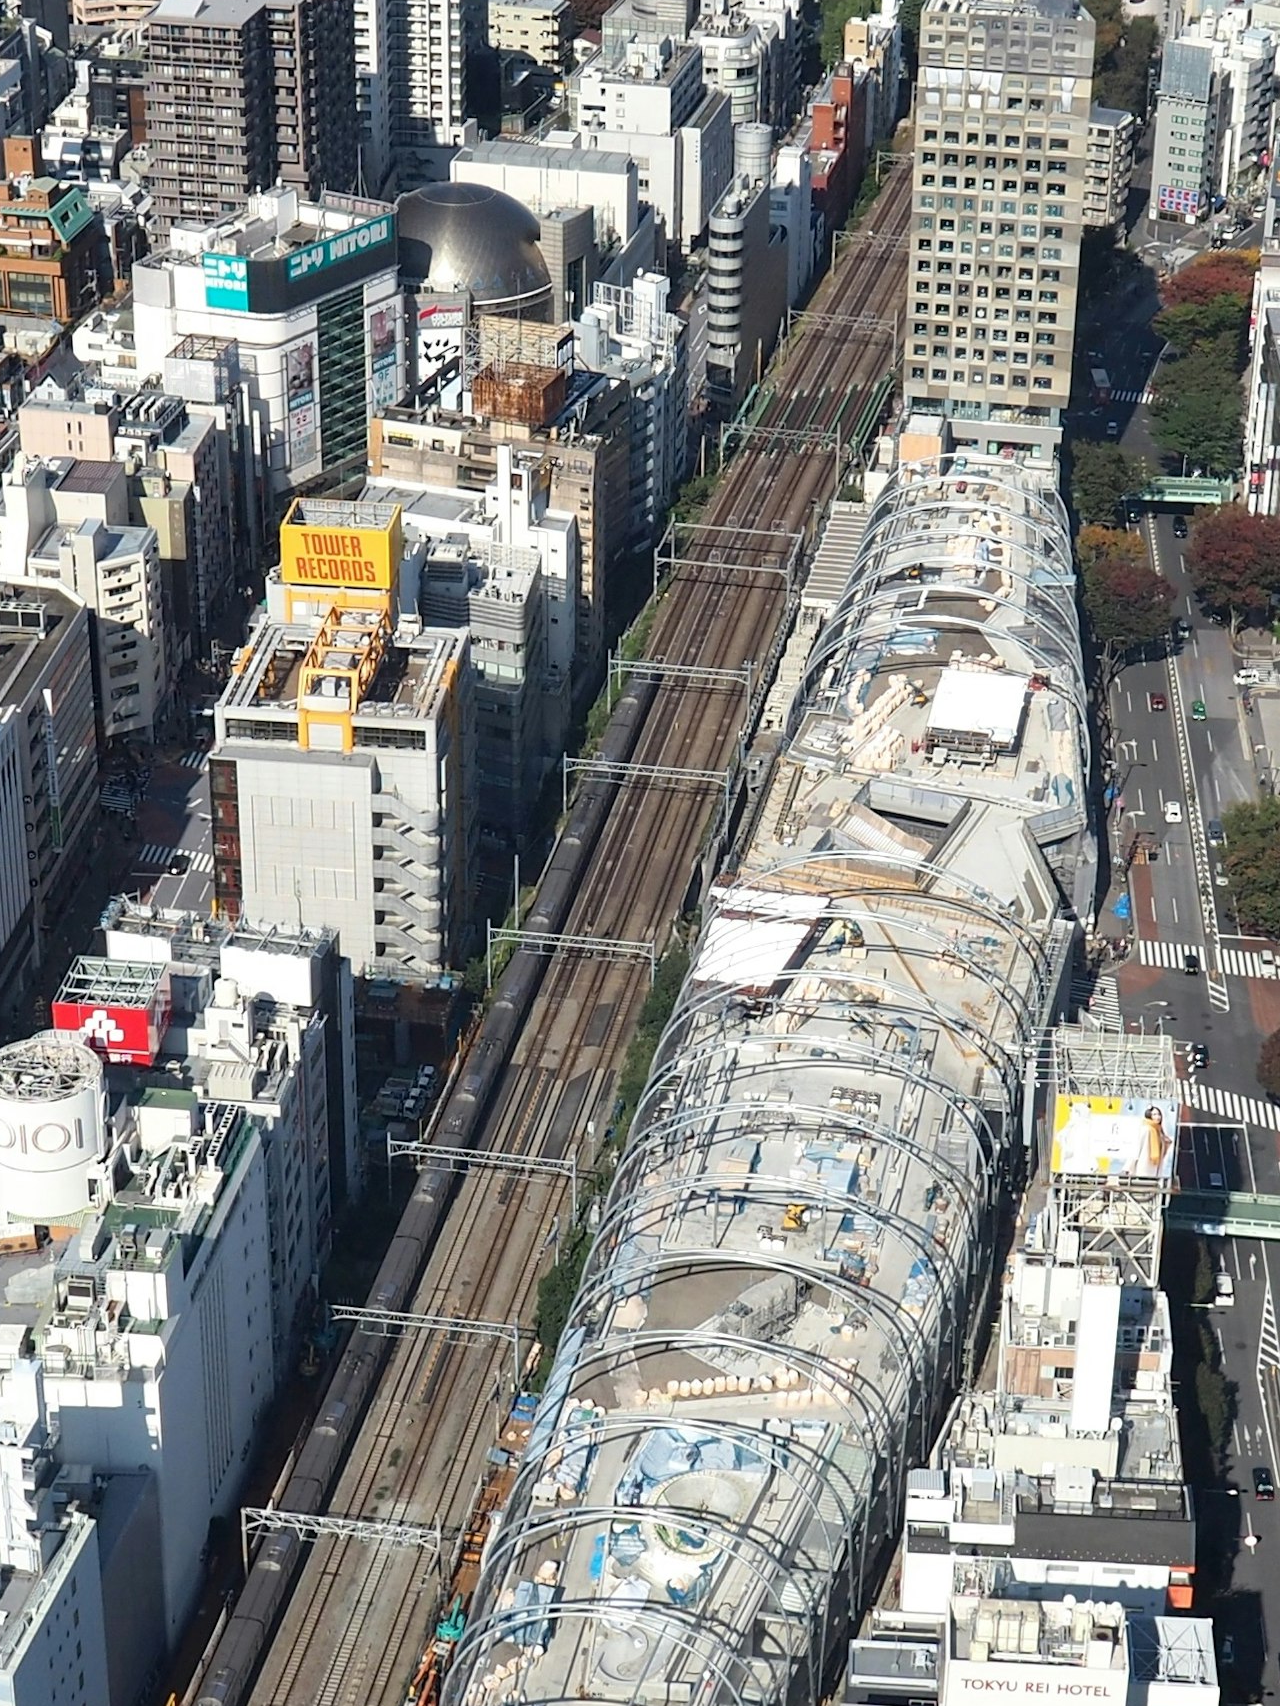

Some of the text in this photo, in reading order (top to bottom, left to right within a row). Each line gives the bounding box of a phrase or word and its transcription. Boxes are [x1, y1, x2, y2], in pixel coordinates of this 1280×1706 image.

[290, 220, 389, 279] ニトリ NITORI
[204, 258, 246, 280] ニトリ
[205, 277, 247, 291] NITORI
[373, 353, 397, 371] NITORI
[377, 369, 391, 383] 9F
[289, 393, 312, 410] NITORI
[300, 533, 364, 558] TOWER
[295, 557, 378, 583] RECORDS
[961, 1678, 1112, 1698] TOKYU REI HOTEL
